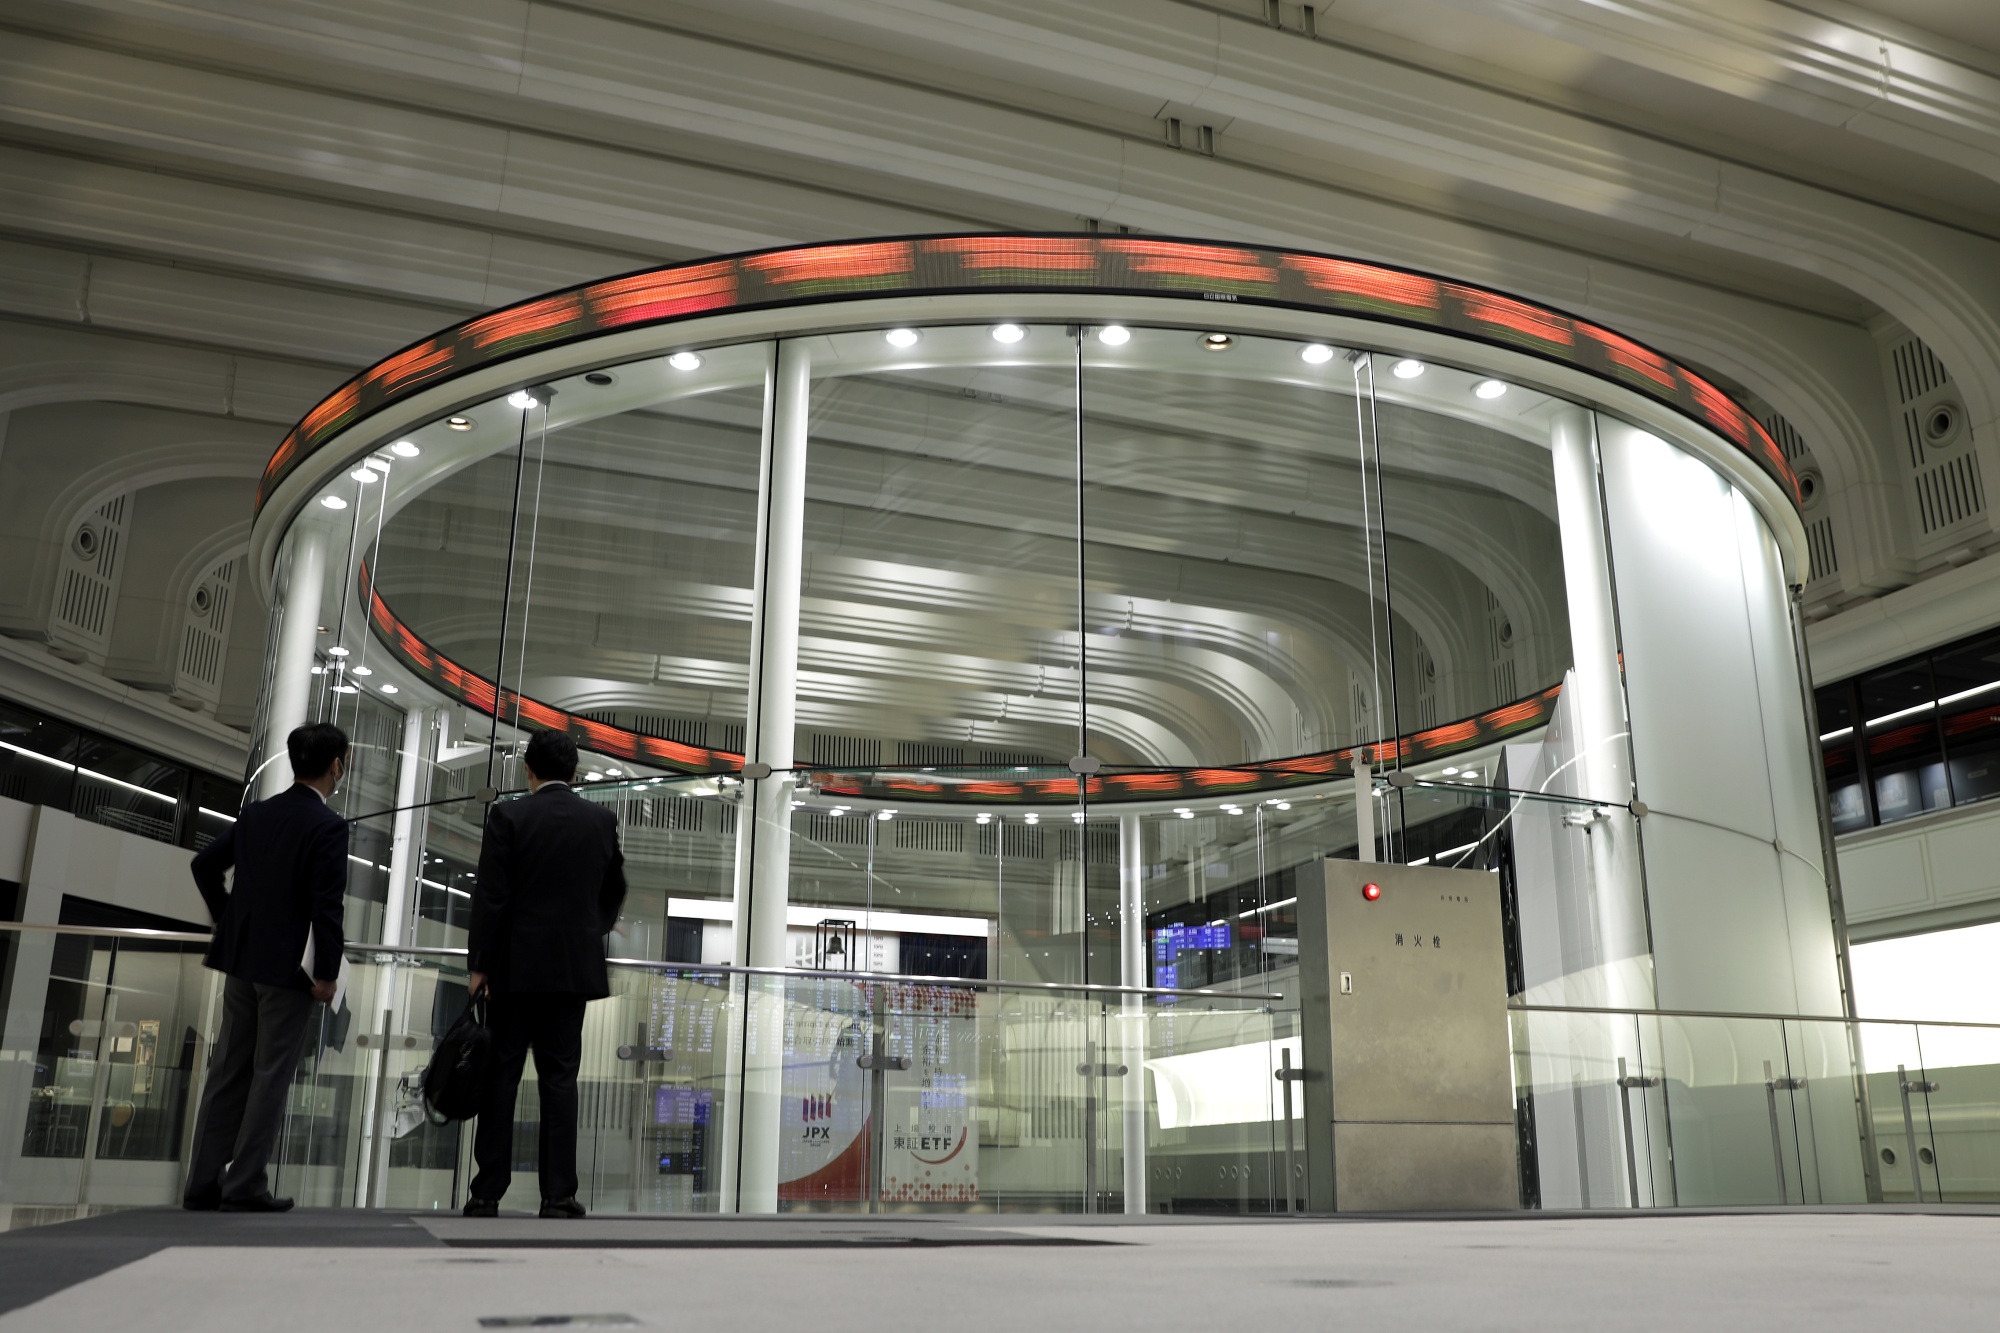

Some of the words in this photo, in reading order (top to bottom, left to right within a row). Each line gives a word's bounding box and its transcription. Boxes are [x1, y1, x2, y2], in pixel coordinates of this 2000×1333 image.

[1395, 933, 1441, 948] 消火栓
[802, 1126, 830, 1140] JPX
